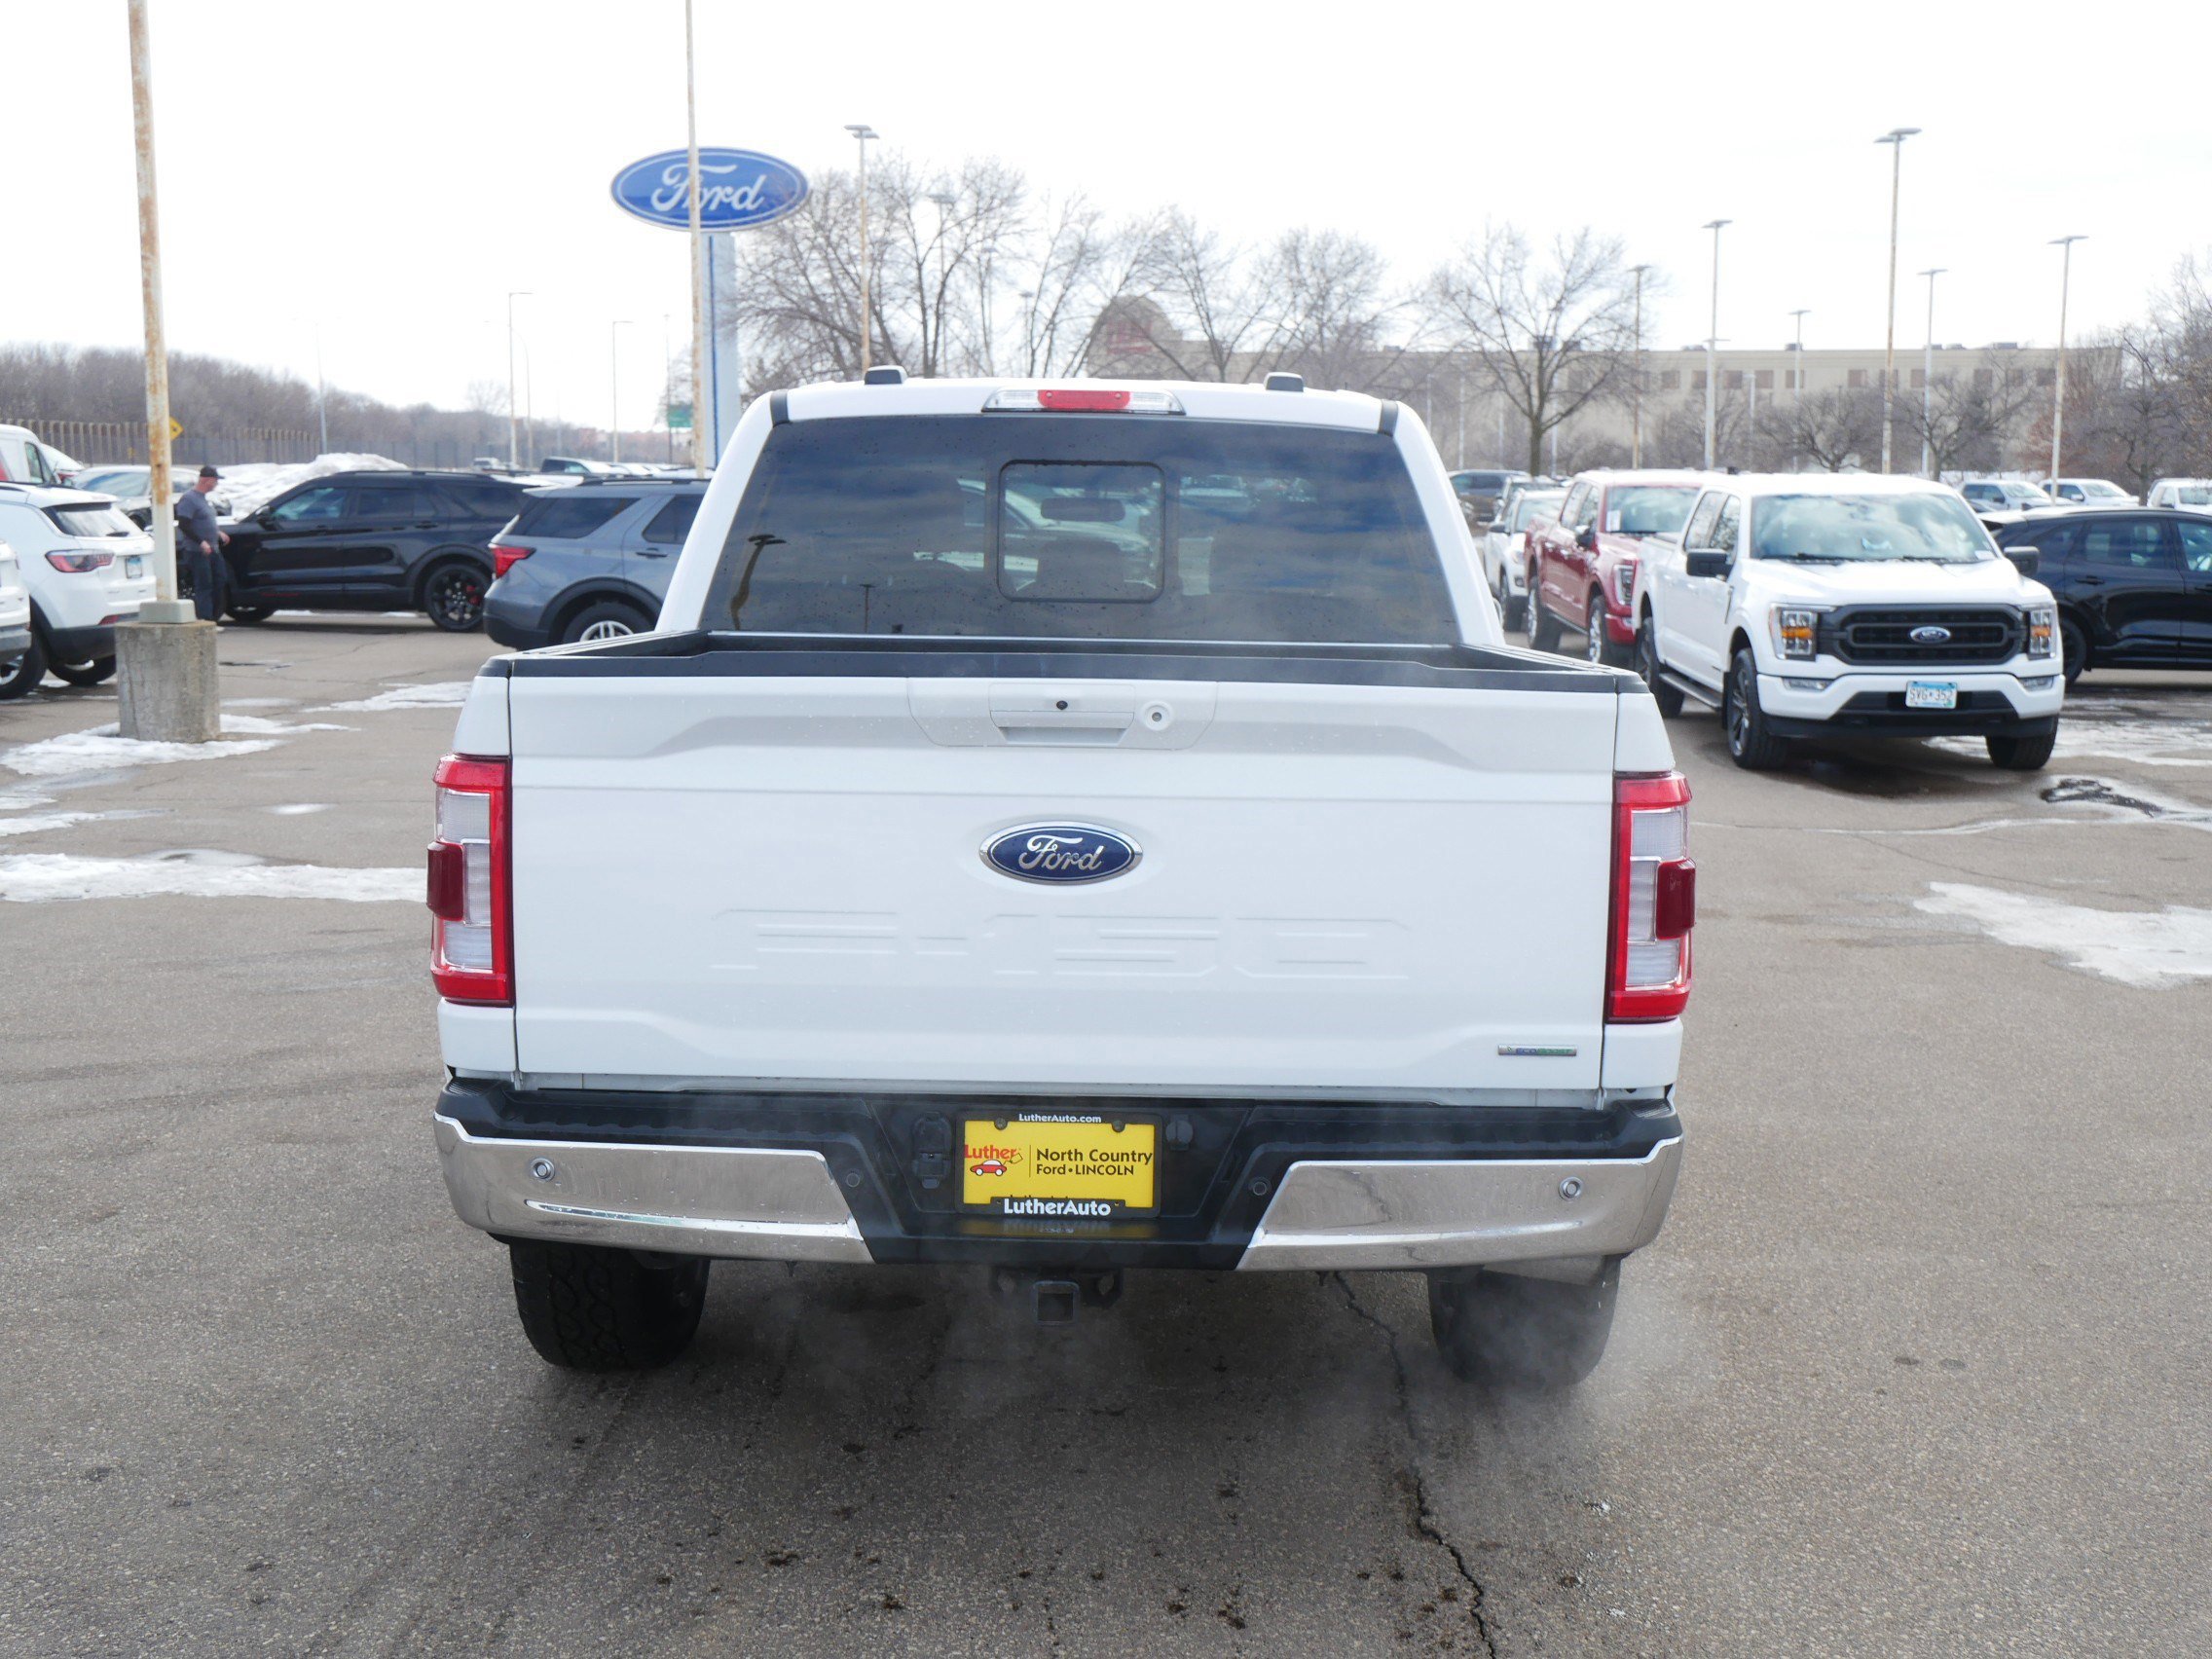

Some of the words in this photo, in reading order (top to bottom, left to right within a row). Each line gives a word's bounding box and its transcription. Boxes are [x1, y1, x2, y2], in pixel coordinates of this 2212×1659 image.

[650, 162, 767, 211] Ford
[1018, 834, 1104, 870] Ford
[1018, 1113, 1102, 1124] LutherAuto.com
[963, 1144, 1017, 1161] Luther
[1036, 1148, 1084, 1162] North
[1088, 1149, 1154, 1165] Country
[1036, 1163, 1066, 1175] Ford
[1075, 1164, 1134, 1176] LINCOLN
[1004, 1198, 1112, 1217] LutherAuto
